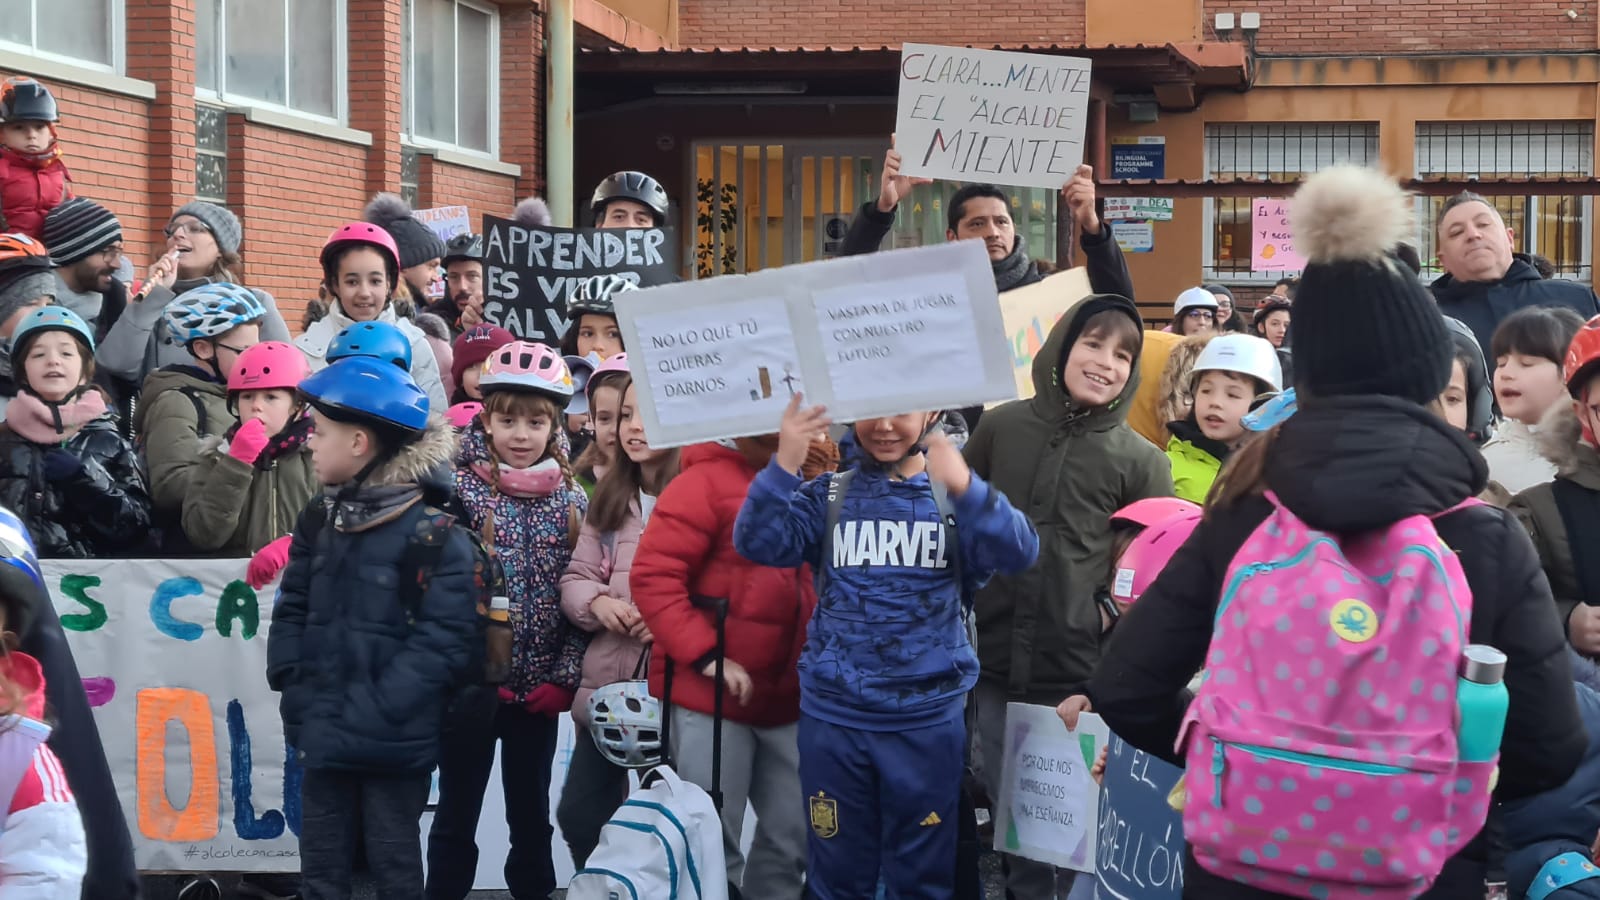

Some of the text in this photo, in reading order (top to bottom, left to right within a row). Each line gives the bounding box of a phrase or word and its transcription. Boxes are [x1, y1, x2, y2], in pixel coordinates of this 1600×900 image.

[910, 94, 946, 122] EL
[922, 127, 1081, 174] MIENTE
[485, 224, 665, 271] APRENDER
[487, 265, 520, 300] ES
[911, 293, 957, 310] JUGAR
[483, 301, 575, 341] SALV
[651, 317, 759, 350] NO LO QUE TÚ
[833, 319, 927, 342] CON NUESTRO
[658, 351, 723, 374] QUIERAS
[833, 520, 948, 569] MARVEL
[1055, 759, 1073, 776] NOS
[1131, 749, 1157, 788] EL
